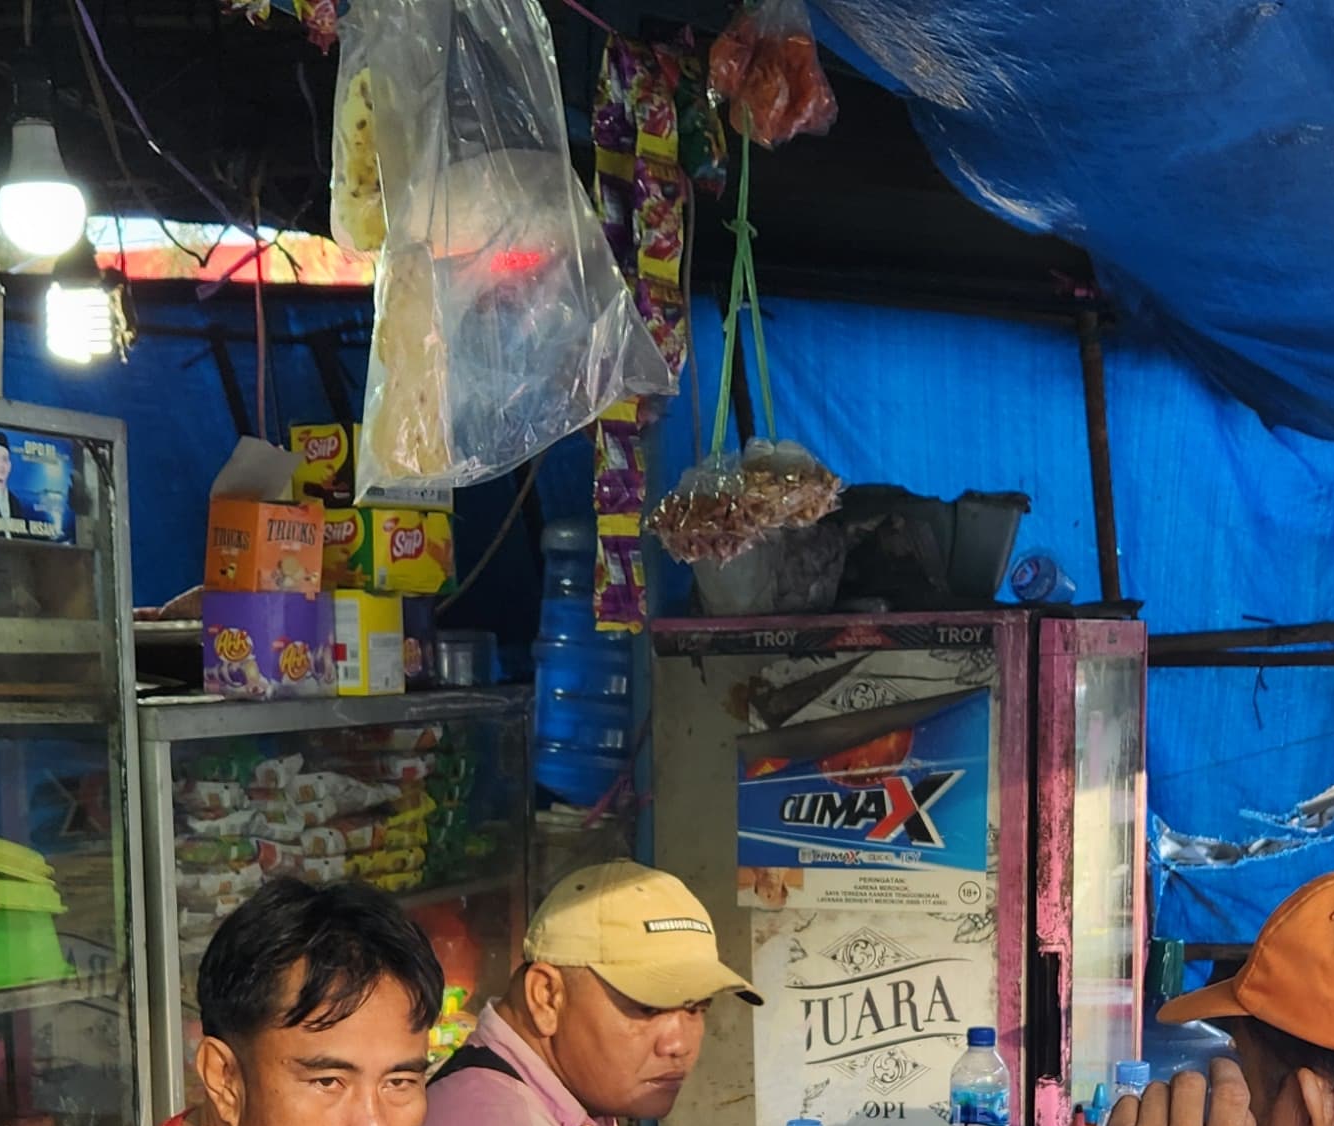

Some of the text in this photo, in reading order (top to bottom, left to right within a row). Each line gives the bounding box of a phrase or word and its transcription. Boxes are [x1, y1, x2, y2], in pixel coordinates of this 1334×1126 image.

[266, 518, 317, 546] TRICKS
[754, 631, 798, 647] TROY
[938, 626, 984, 643] TROY
[962, 887, 979, 899] 18+
